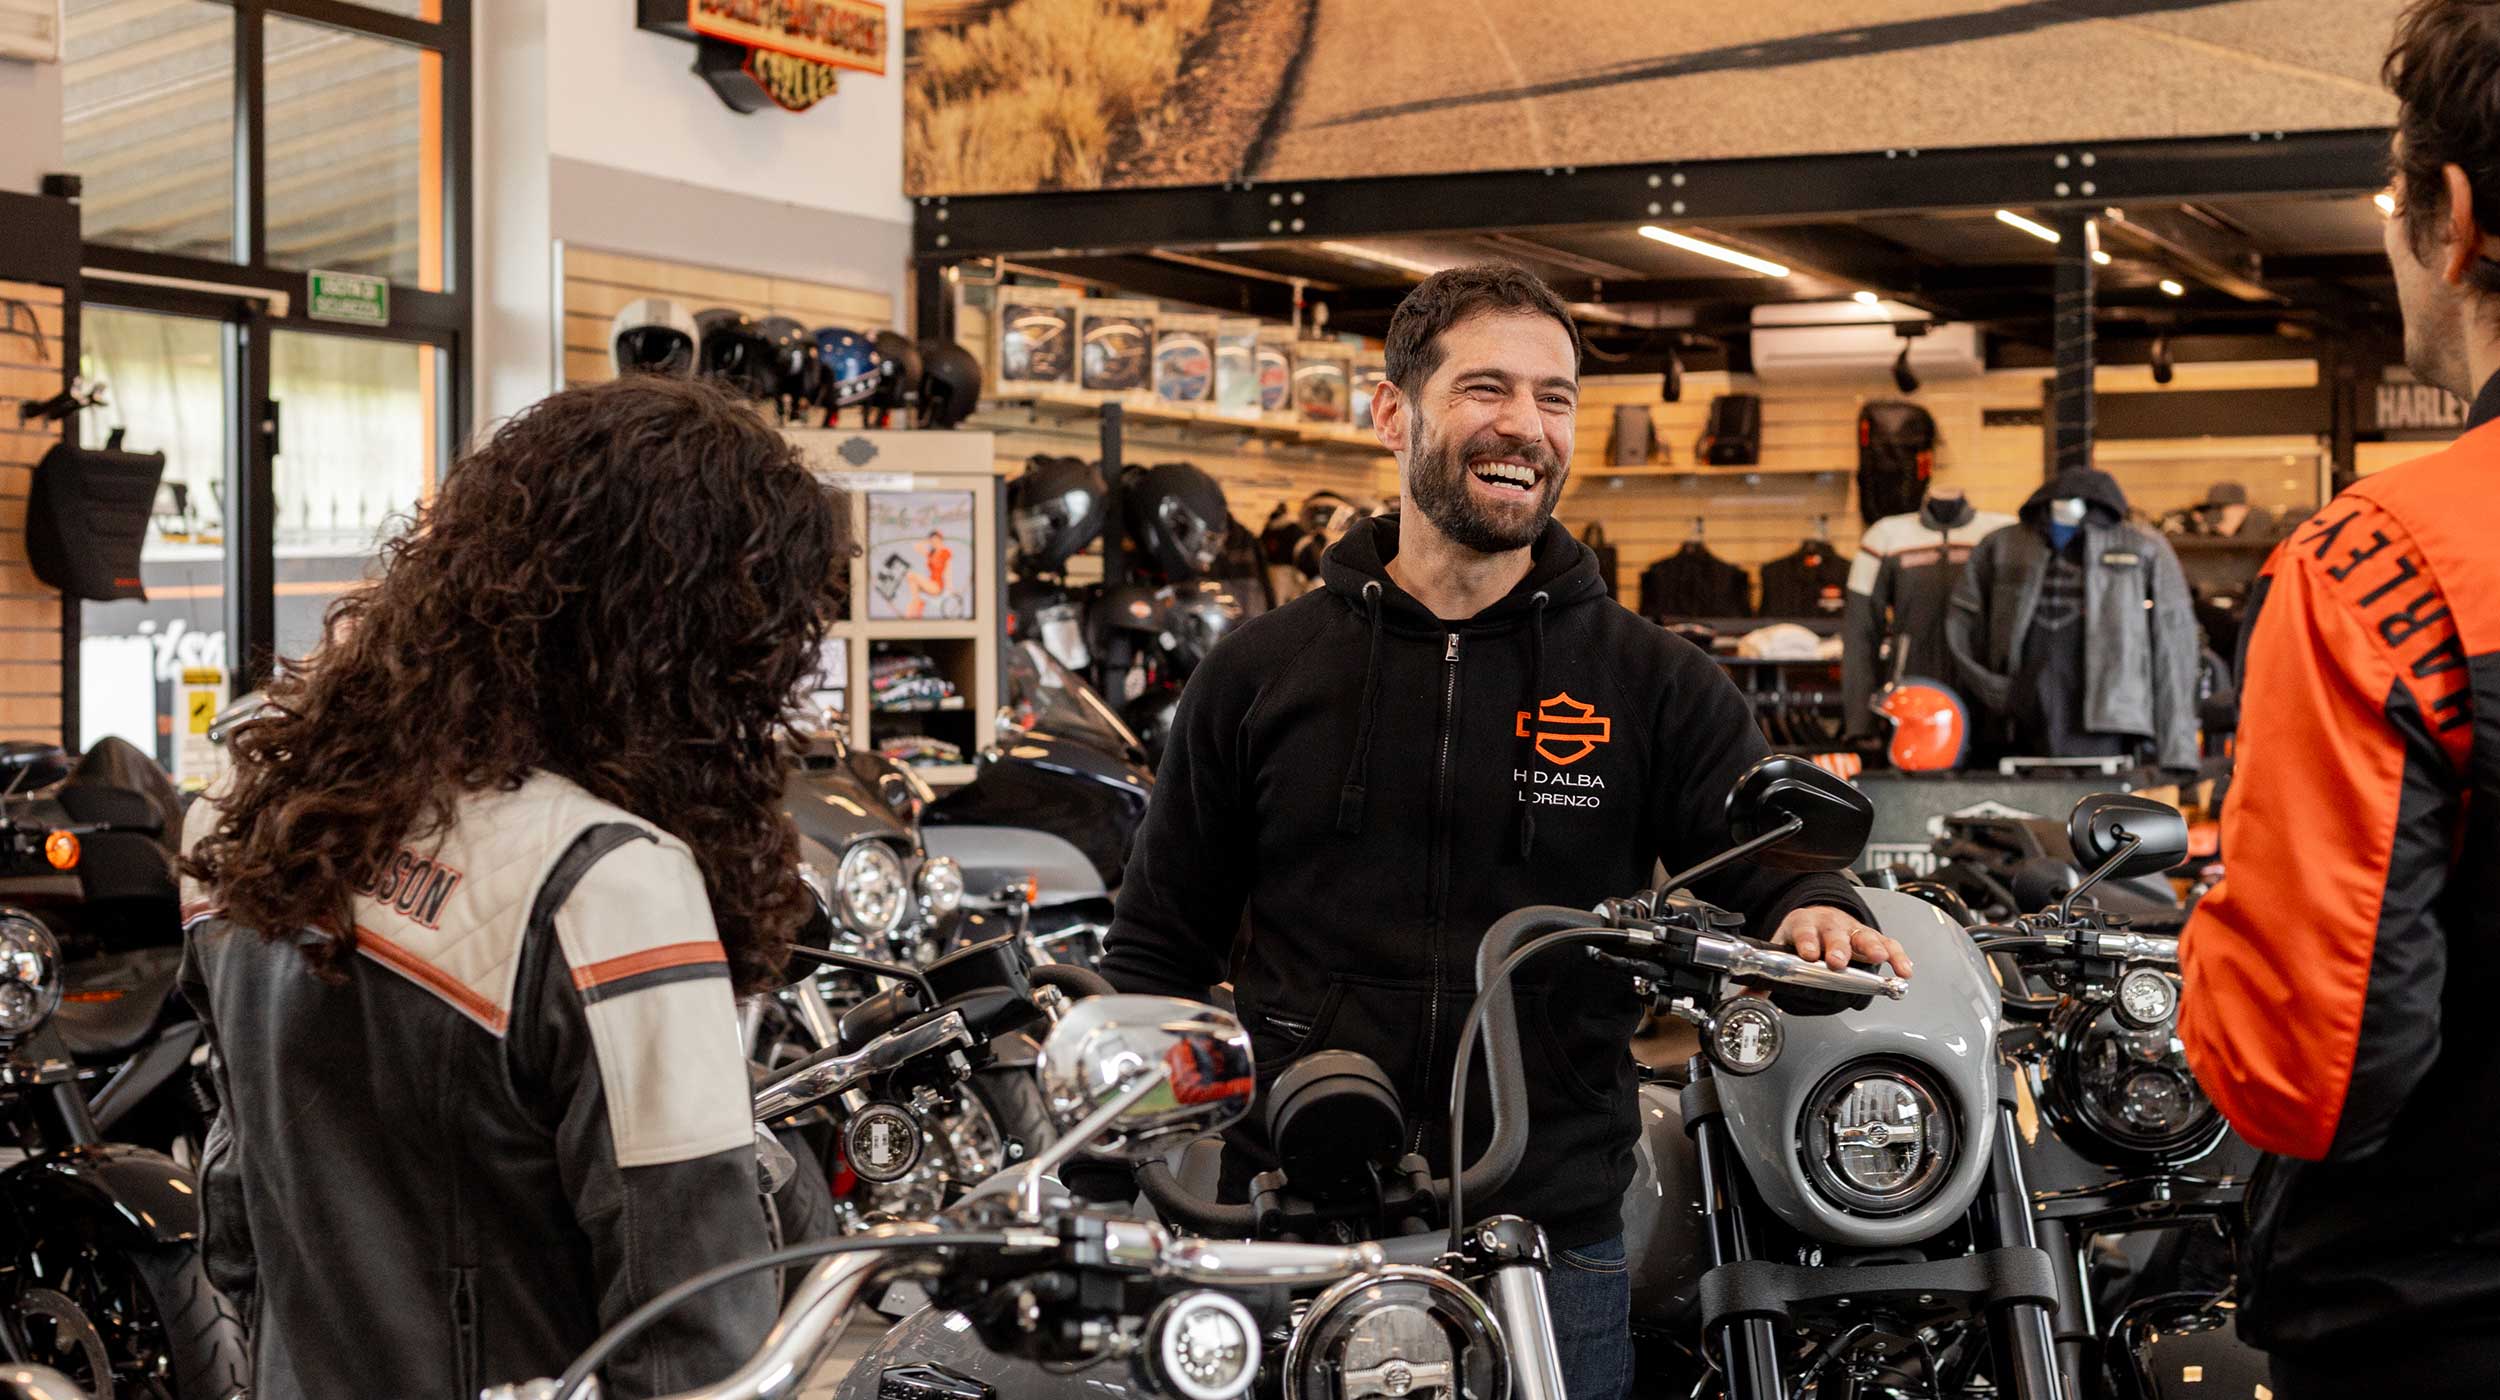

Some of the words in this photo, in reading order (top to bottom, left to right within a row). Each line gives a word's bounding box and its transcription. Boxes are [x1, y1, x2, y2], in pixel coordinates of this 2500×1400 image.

[2300, 510, 2471, 733] HARLEY
[1551, 772, 1605, 789] ALBA
[1518, 790, 1600, 808] LORENZO
